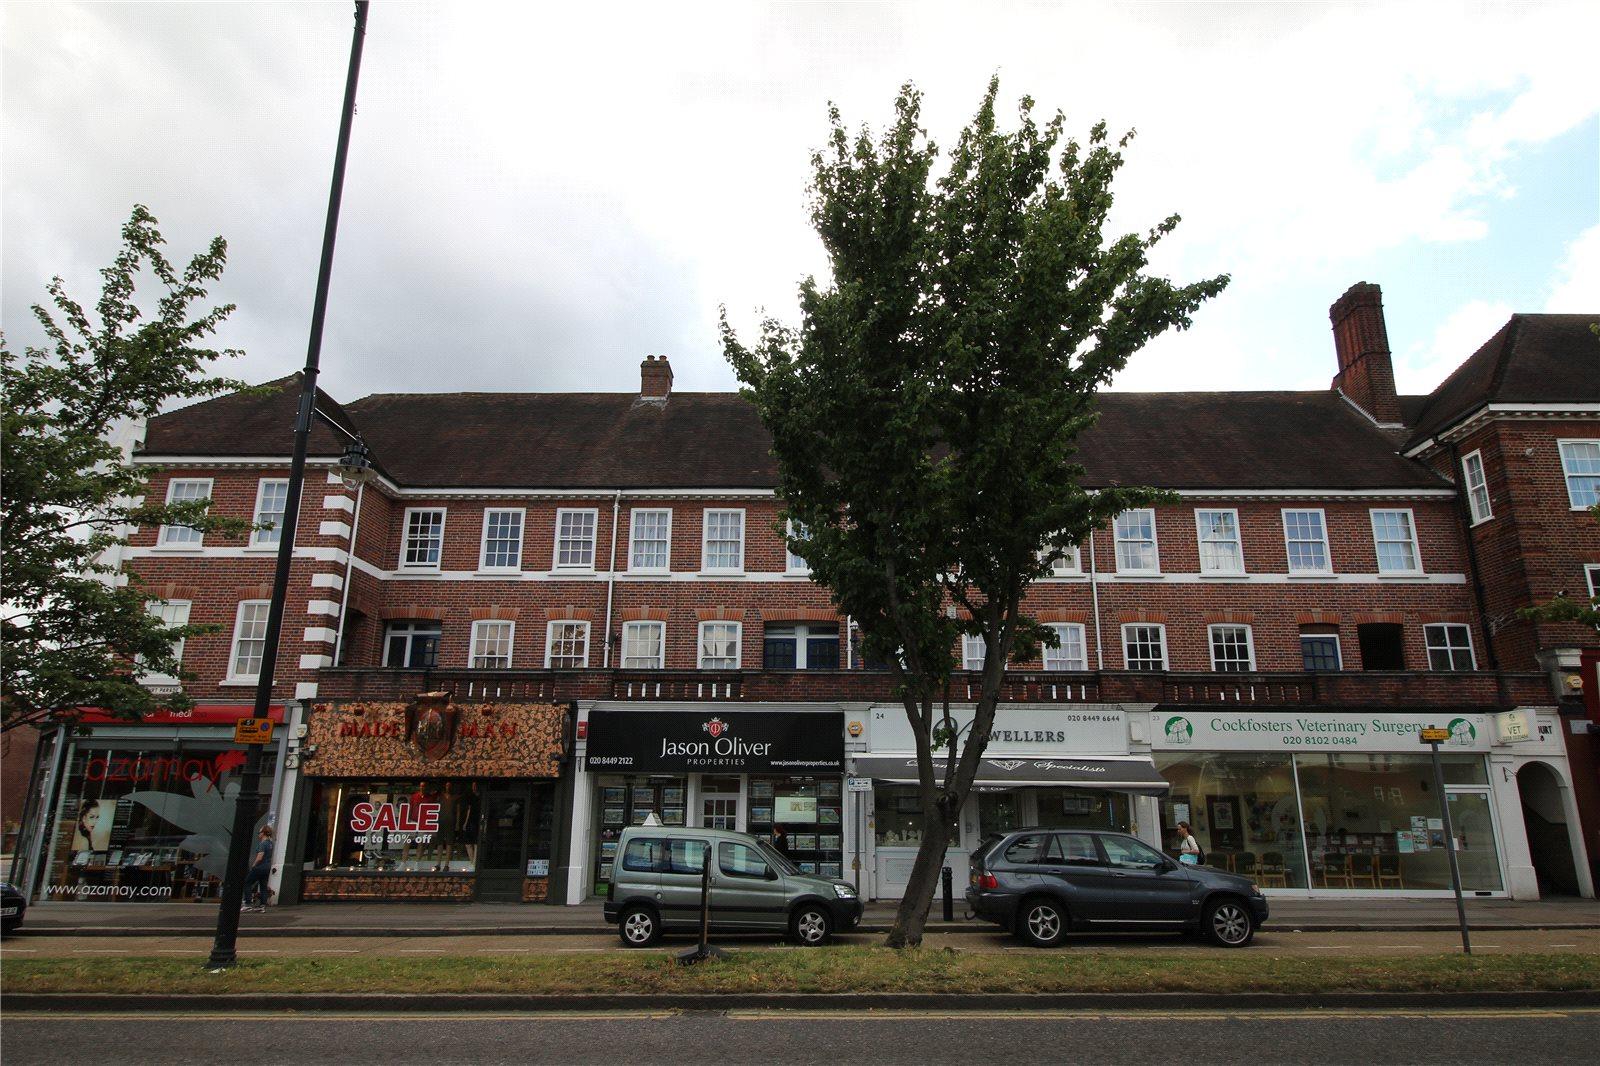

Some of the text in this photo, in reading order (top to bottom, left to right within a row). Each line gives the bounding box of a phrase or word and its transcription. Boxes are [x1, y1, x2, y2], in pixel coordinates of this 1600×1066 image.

[876, 712, 885, 720] 24
[1068, 714, 1120, 723] 020 8449 6644
[1210, 718, 1426, 736] Cockfosters Veterinary Surgery
[1507, 725, 1521, 735] VET
[1282, 736, 1358, 745] 020 8102 0484
[660, 736, 772, 758] Jason Oliver
[589, 756, 633, 765] 020 8449 2122
[687, 758, 745, 766] PROPERTIES
[1033, 759, 1106, 773] Specialists
[86, 756, 223, 793] azamay
[350, 803, 441, 833] SALE
[353, 834, 432, 845] up to 50% off
[44, 884, 172, 899] www.azamay.com
